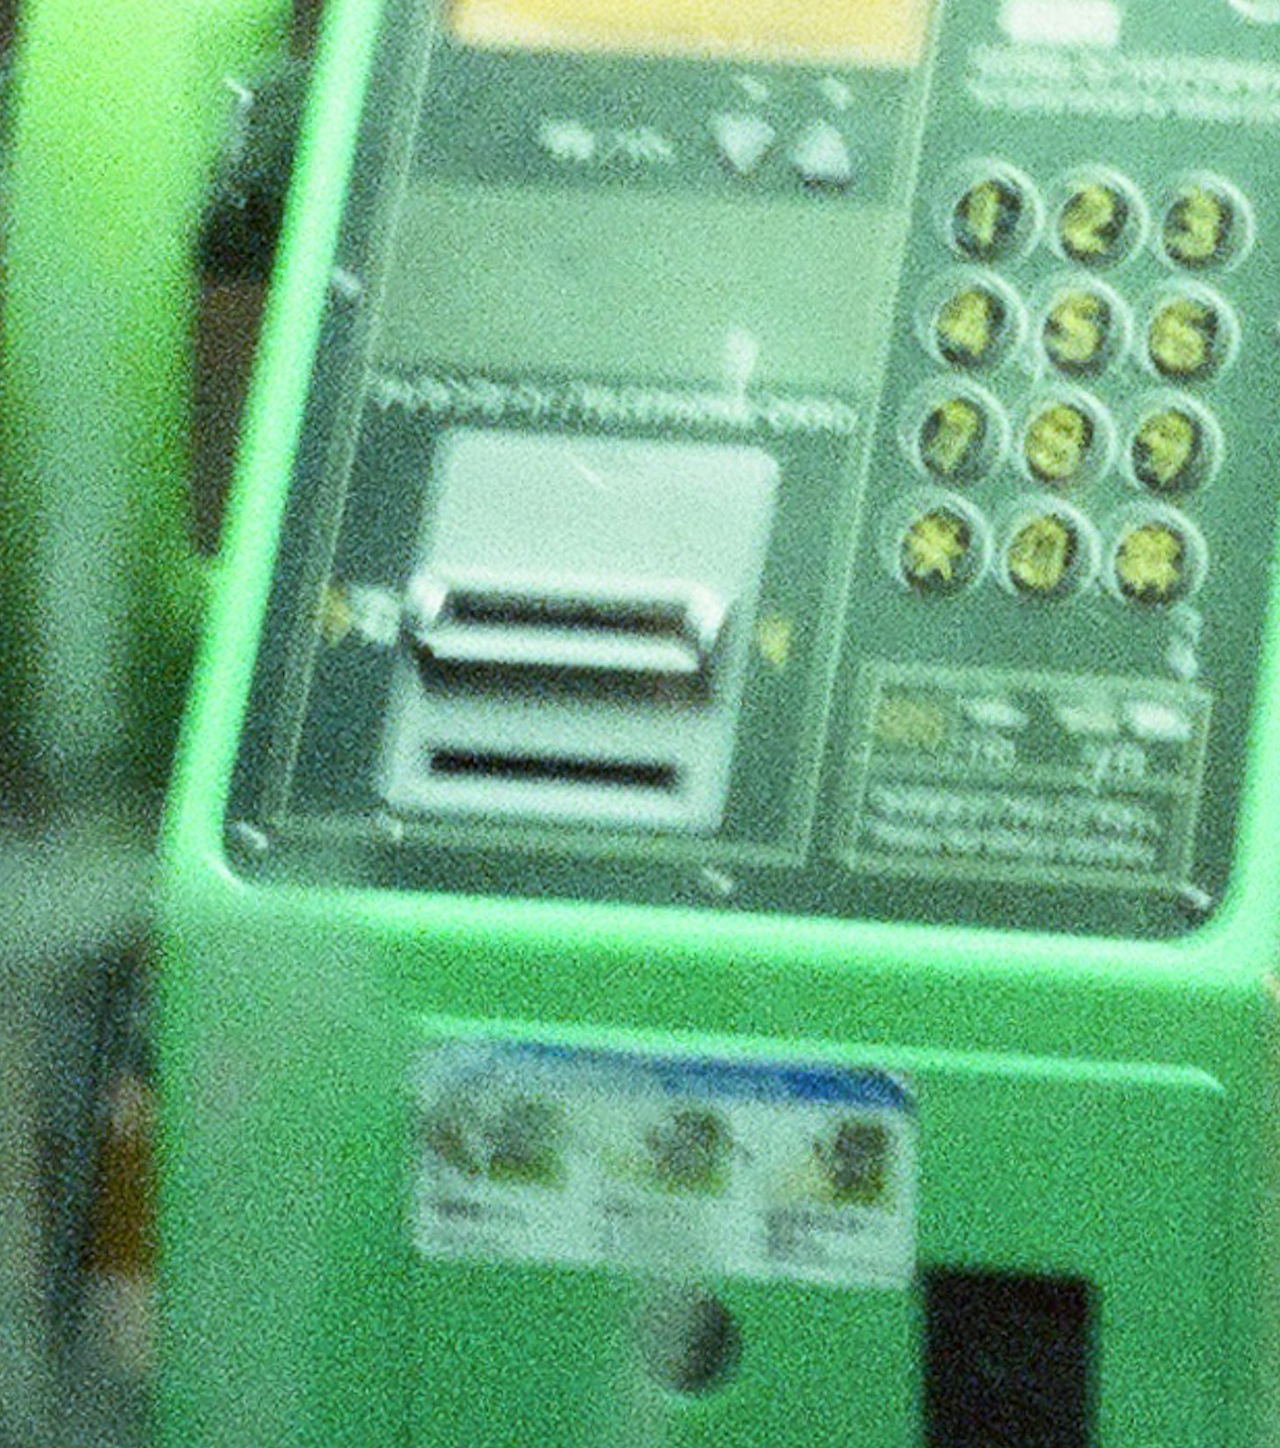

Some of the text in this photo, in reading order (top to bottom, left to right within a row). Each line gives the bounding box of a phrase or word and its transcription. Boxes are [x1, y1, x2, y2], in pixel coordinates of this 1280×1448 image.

[1061, 186, 1116, 256] 2
[1173, 190, 1222, 260] 3
[936, 290, 989, 358] 4
[1024, 404, 1086, 480] 8
[1136, 410, 1197, 486] 9
